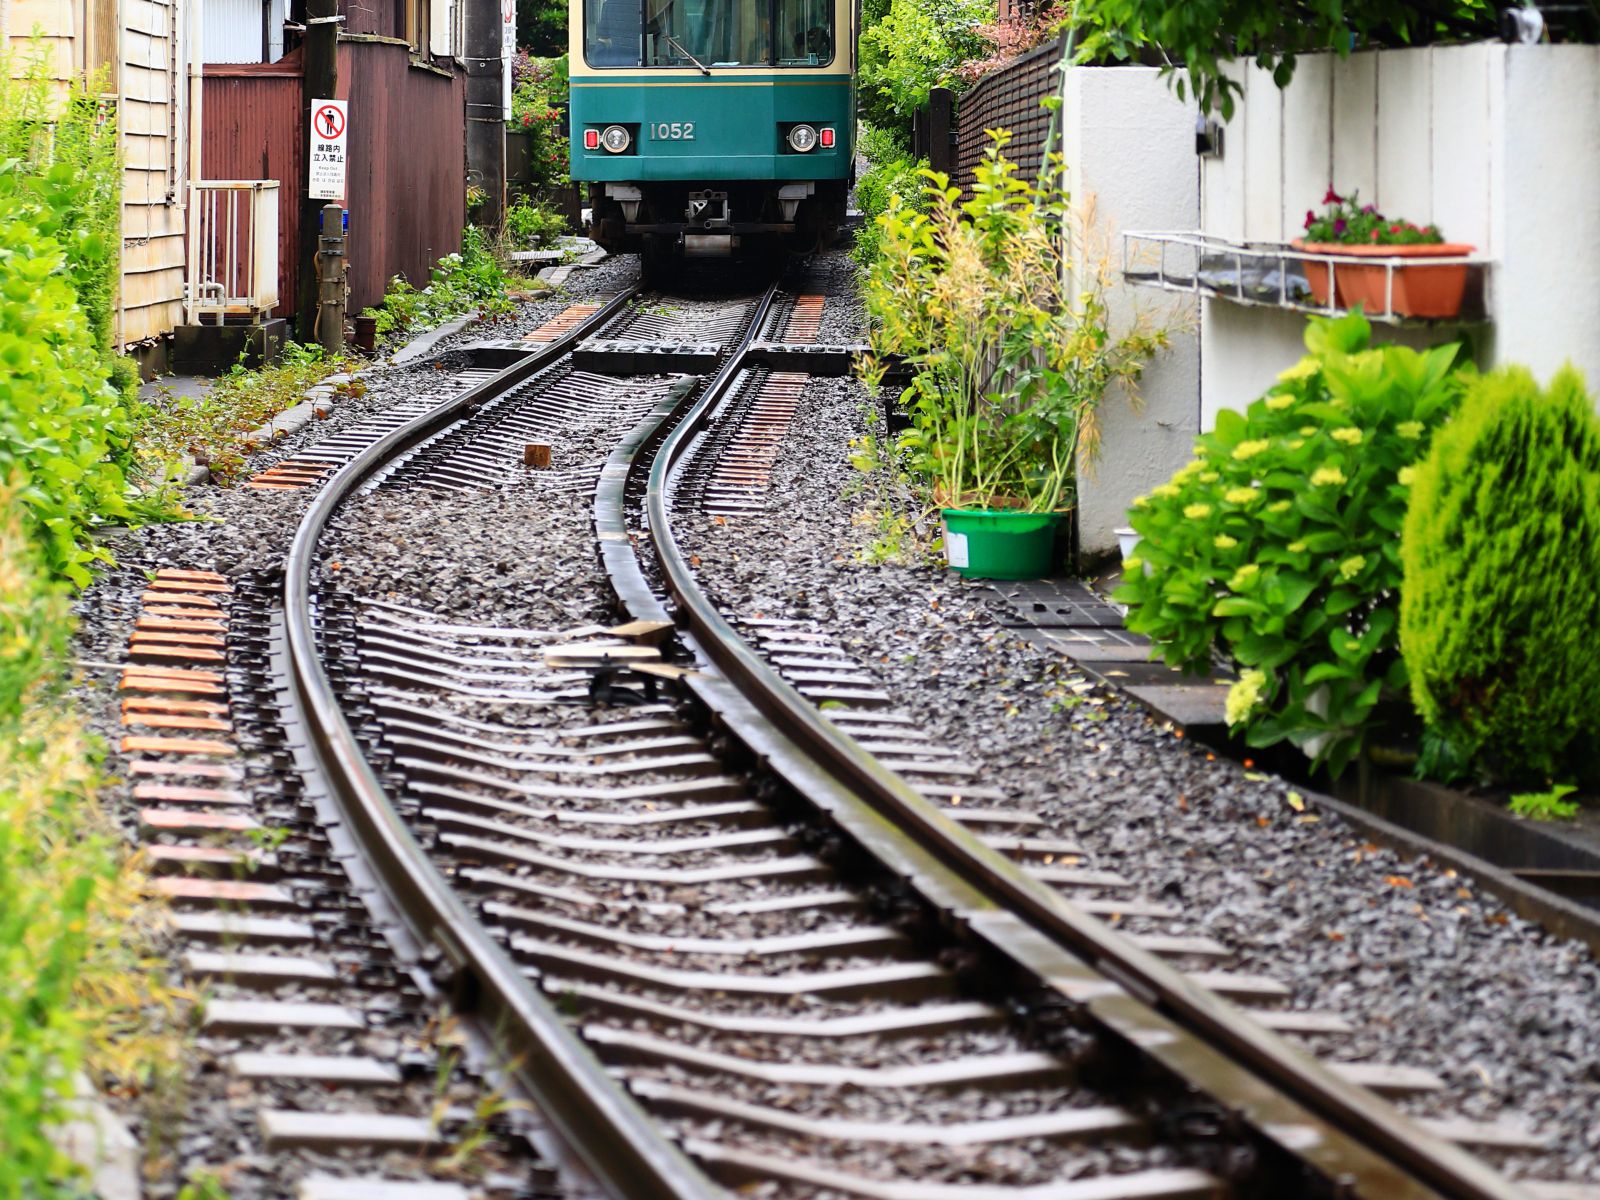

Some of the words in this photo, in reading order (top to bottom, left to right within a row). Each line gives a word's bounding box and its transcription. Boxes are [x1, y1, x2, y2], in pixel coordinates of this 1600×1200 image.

[651, 123, 694, 139] 1052
[317, 144, 341, 153] 線路内
[313, 154, 344, 163] 立入禁止
